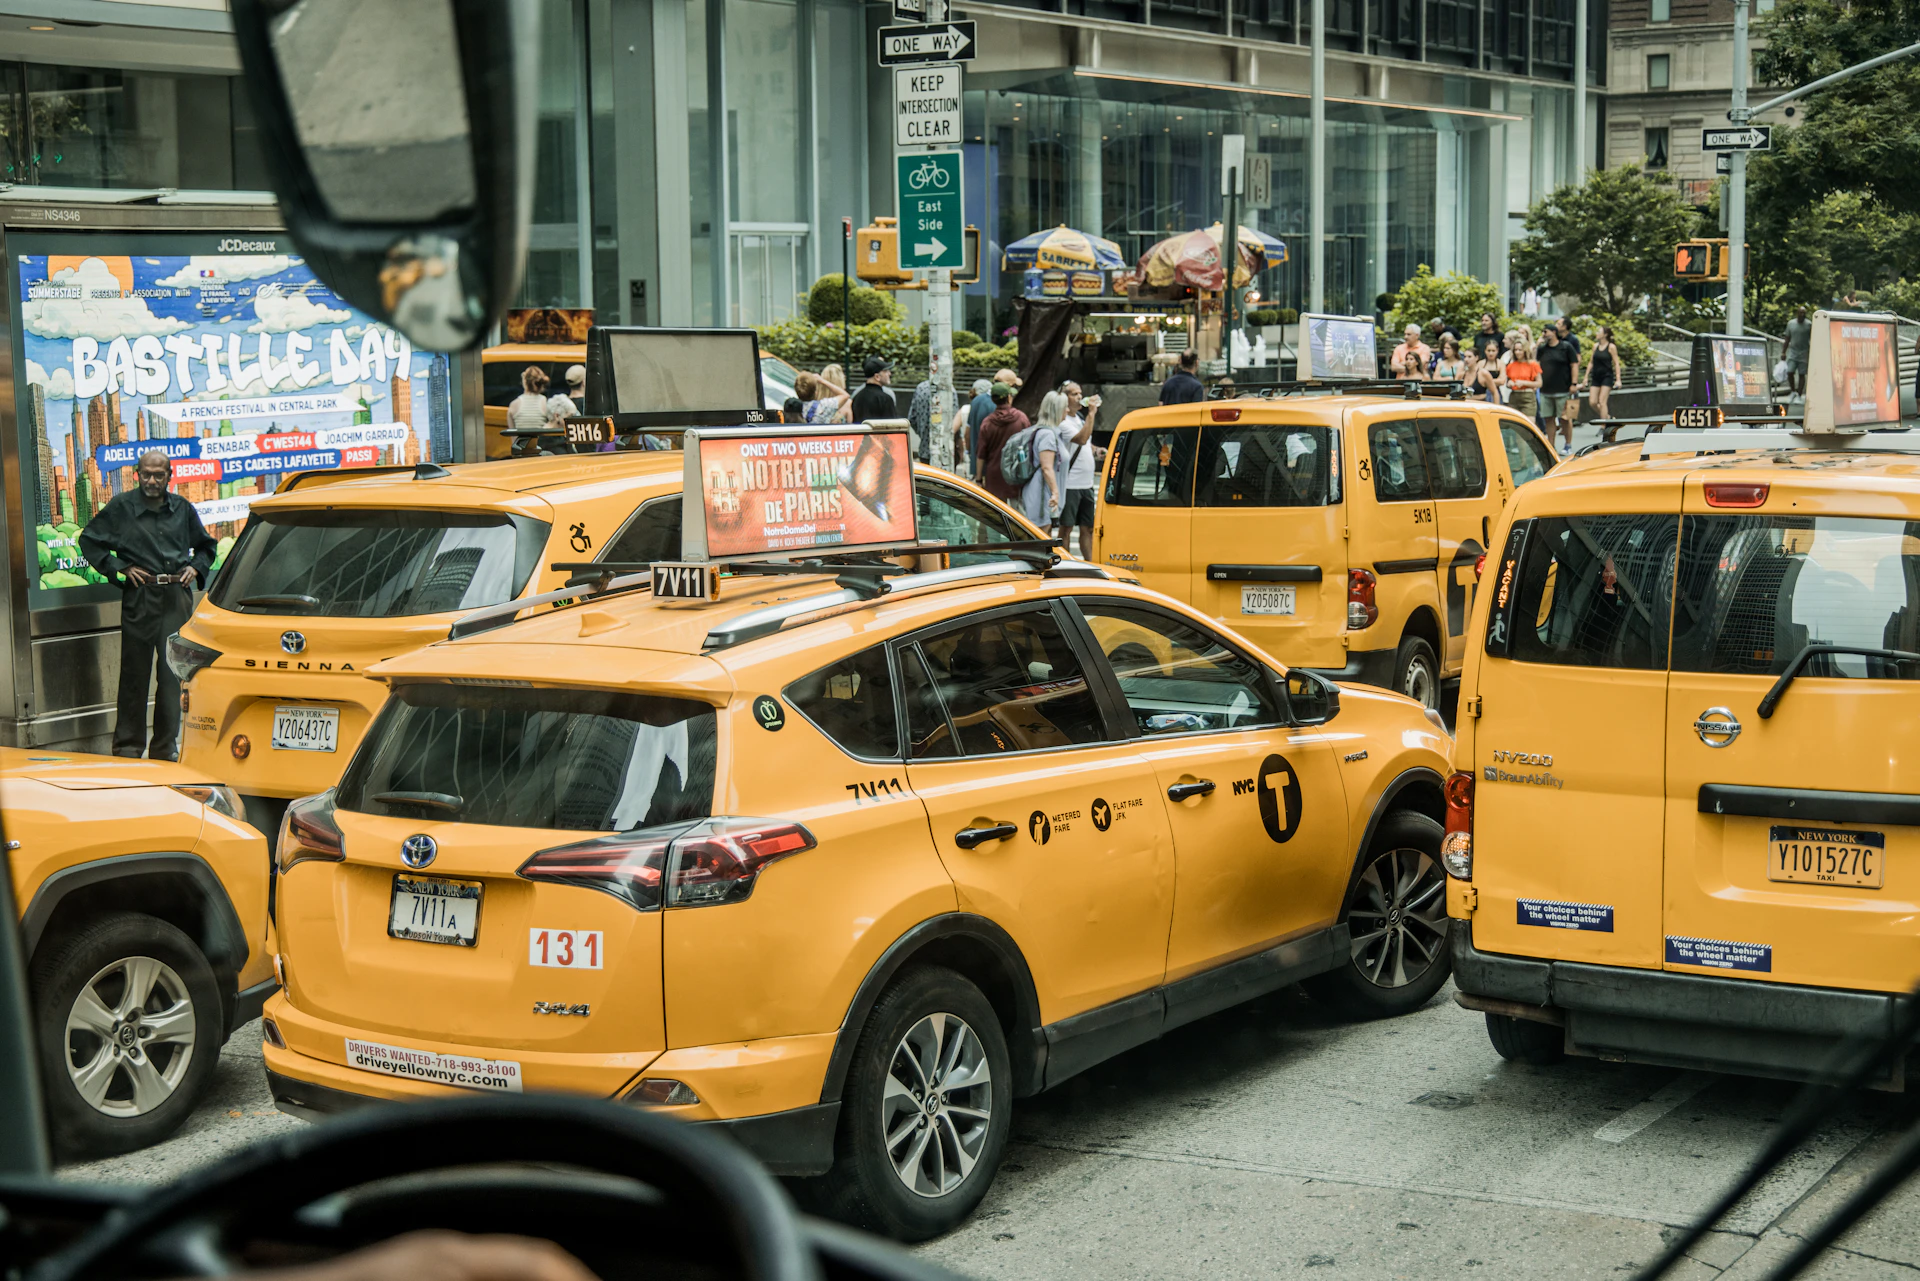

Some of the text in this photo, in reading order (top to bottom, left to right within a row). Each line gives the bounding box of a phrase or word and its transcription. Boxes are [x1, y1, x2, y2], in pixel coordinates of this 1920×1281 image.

[893, 34, 961, 53] ONE WAY
[911, 75, 944, 92] KEEP
[899, 97, 958, 115] INTERSECTION
[908, 120, 950, 138] CLEAR
[1712, 134, 1760, 144] ONE WAY
[918, 200, 942, 213] East
[44, 210, 81, 222] NS4346
[918, 218, 943, 231] Side
[217, 239, 276, 252] JCDecaux
[28, 287, 82, 299] SUMMERSTAGE
[91, 290, 120, 299] PRESENTS
[134, 289, 172, 298] ASSOCIATION
[72, 326, 412, 399] BASTILLE DAY
[181, 399, 338, 418] A FRENCH FESTIVAL IN CENTRAL PARK
[1679, 409, 1712, 427] 6E51
[324, 429, 404, 445] JOACHIM GARRAUD
[568, 423, 601, 442] 3H16
[104, 447, 135, 462] ADELE
[207, 440, 250, 454] BENABAR
[741, 440, 855, 457] ONLY TWO WEEKS LEFT
[224, 452, 336, 473] LES CADETS LAFAYETTE
[346, 450, 372, 463] PASSI
[176, 463, 215, 478] BERSON
[742, 458, 805, 492] NOTRE
[216, 506, 230, 514] JULY
[764, 488, 843, 524] DE PARIS
[1414, 508, 1432, 524] 5K18
[47, 537, 76, 549] WITH THE
[657, 567, 701, 597] 7V11
[1498, 560, 1516, 609] VACANT
[1246, 593, 1290, 608] Y205087C
[245, 659, 355, 671] SIENNA
[290, 709, 323, 718] NEW YORK
[279, 718, 332, 741] Y206437C
[1699, 723, 1737, 731] NISSAN
[1493, 749, 1554, 767] NV200
[1232, 778, 1255, 796] NYC
[1499, 770, 1565, 790] BraunAbility
[845, 777, 909, 805] 7V11
[1113, 798, 1143, 811] FLAT FARE
[1265, 770, 1291, 832] T
[1052, 810, 1081, 823] METERED
[1115, 812, 1127, 821] JFK
[1054, 823, 1071, 833] FARE
[1797, 831, 1857, 844] NEW YORK
[1779, 843, 1873, 876] Y101527C
[1816, 874, 1835, 882] TAXI
[415, 882, 460, 898] NEW YORK
[1523, 903, 1607, 917] Your choices behind
[1529, 911, 1601, 924] the wheel matter
[536, 931, 598, 967] 131
[1672, 940, 1765, 956] Your choices behind
[1679, 949, 1757, 964] the wheel matter
[1719, 960, 1734, 968] ZERO
[533, 1001, 591, 1017] RAV4
[348, 1041, 387, 1058] DRIVERS
[356, 1054, 509, 1088] driveyellownyc.com
